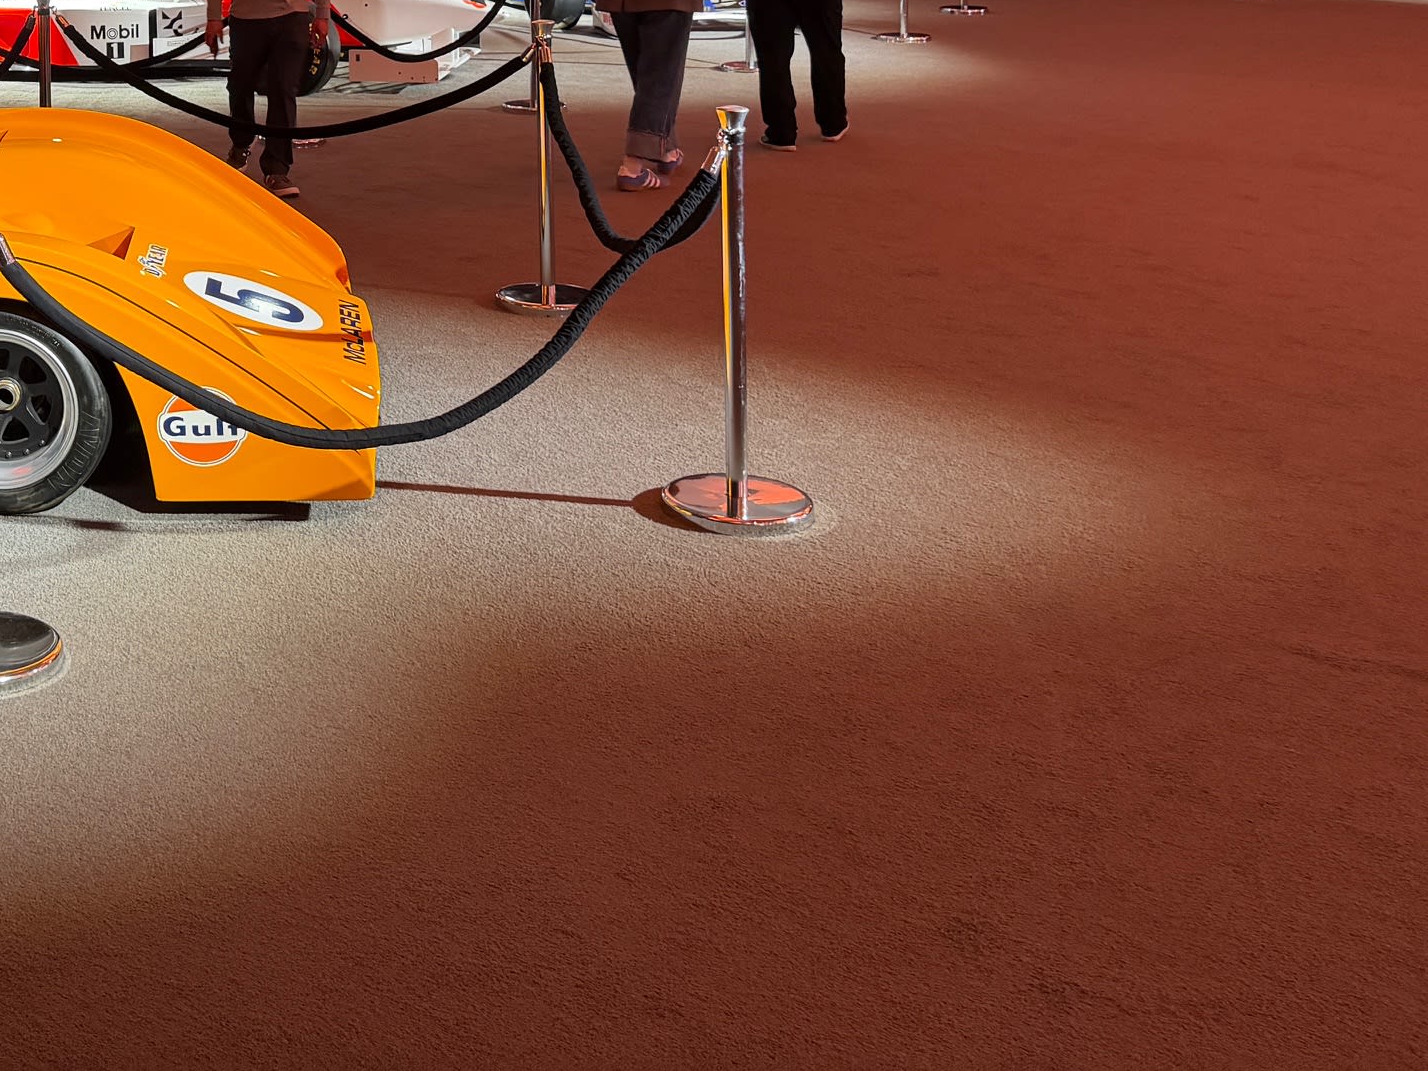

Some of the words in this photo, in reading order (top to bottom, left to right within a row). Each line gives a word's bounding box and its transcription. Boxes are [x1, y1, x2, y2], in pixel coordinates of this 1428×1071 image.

[90, 24, 139, 39] Mobil
[205, 277, 305, 323] 5
[338, 298, 367, 366] McLAREN
